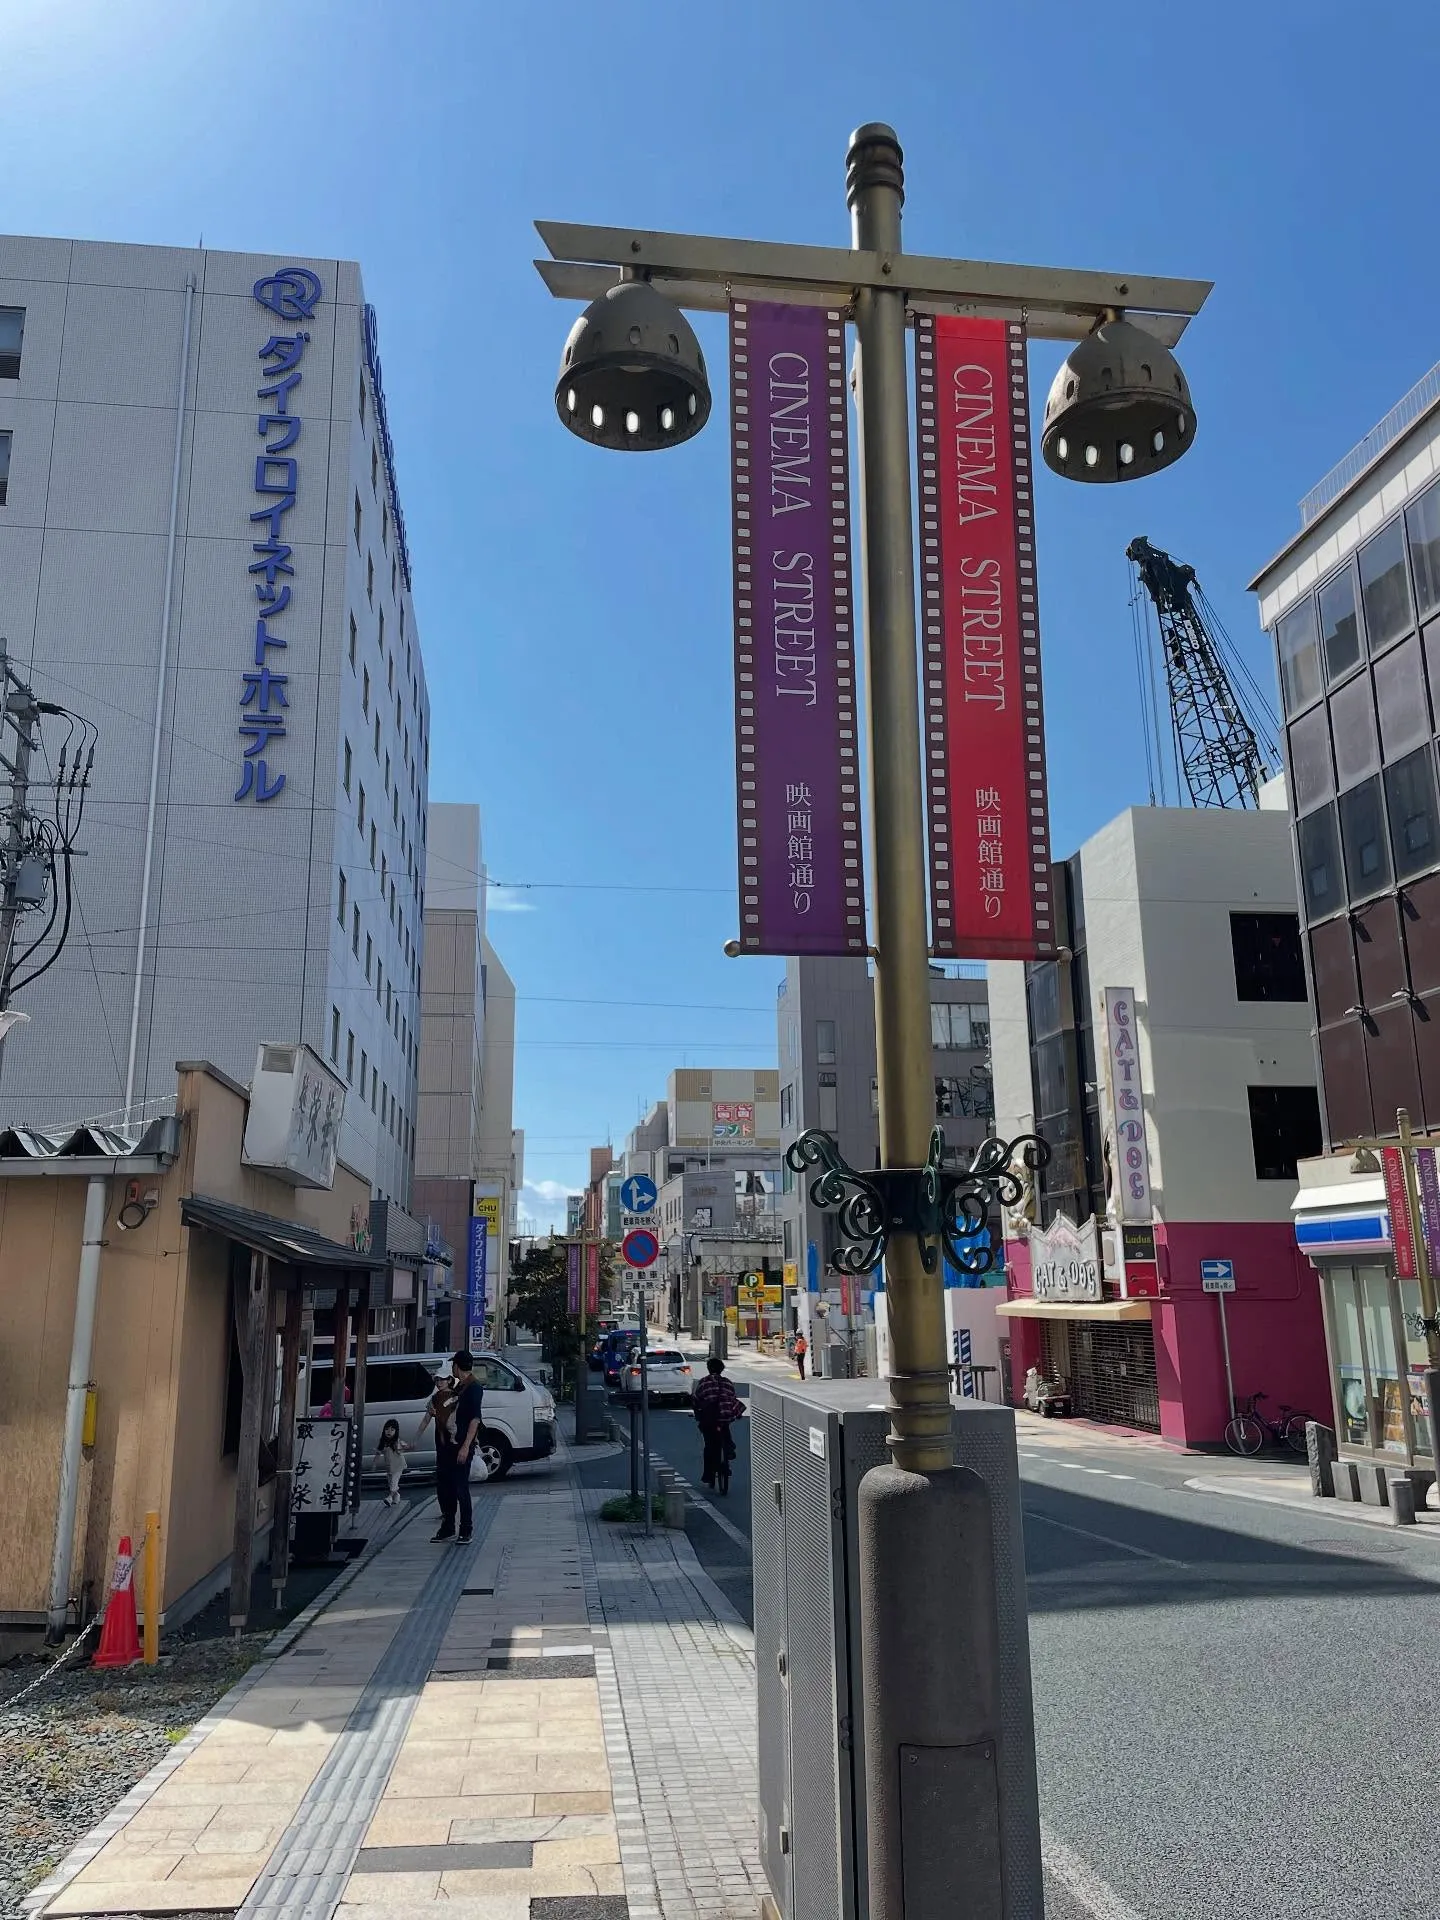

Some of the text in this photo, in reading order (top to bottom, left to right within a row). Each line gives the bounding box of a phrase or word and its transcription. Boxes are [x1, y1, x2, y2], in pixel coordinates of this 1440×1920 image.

[235, 331, 310, 802] ダイワロイネットホテル
[769, 352, 817, 707] CINEMA STREET
[953, 364, 1006, 712] CINEMA STREET
[785, 782, 815, 915] 映画館通り
[975, 786, 1005, 919] 映画館通り
[1113, 1001, 1135, 1081] CAT
[1118, 1119, 1145, 1199] DOG
[1387, 1157, 1401, 1193] CINEMA
[1393, 1198, 1406, 1231] STREET
[1035, 1261, 1056, 1297] CAT
[1069, 1260, 1096, 1297] DOG
